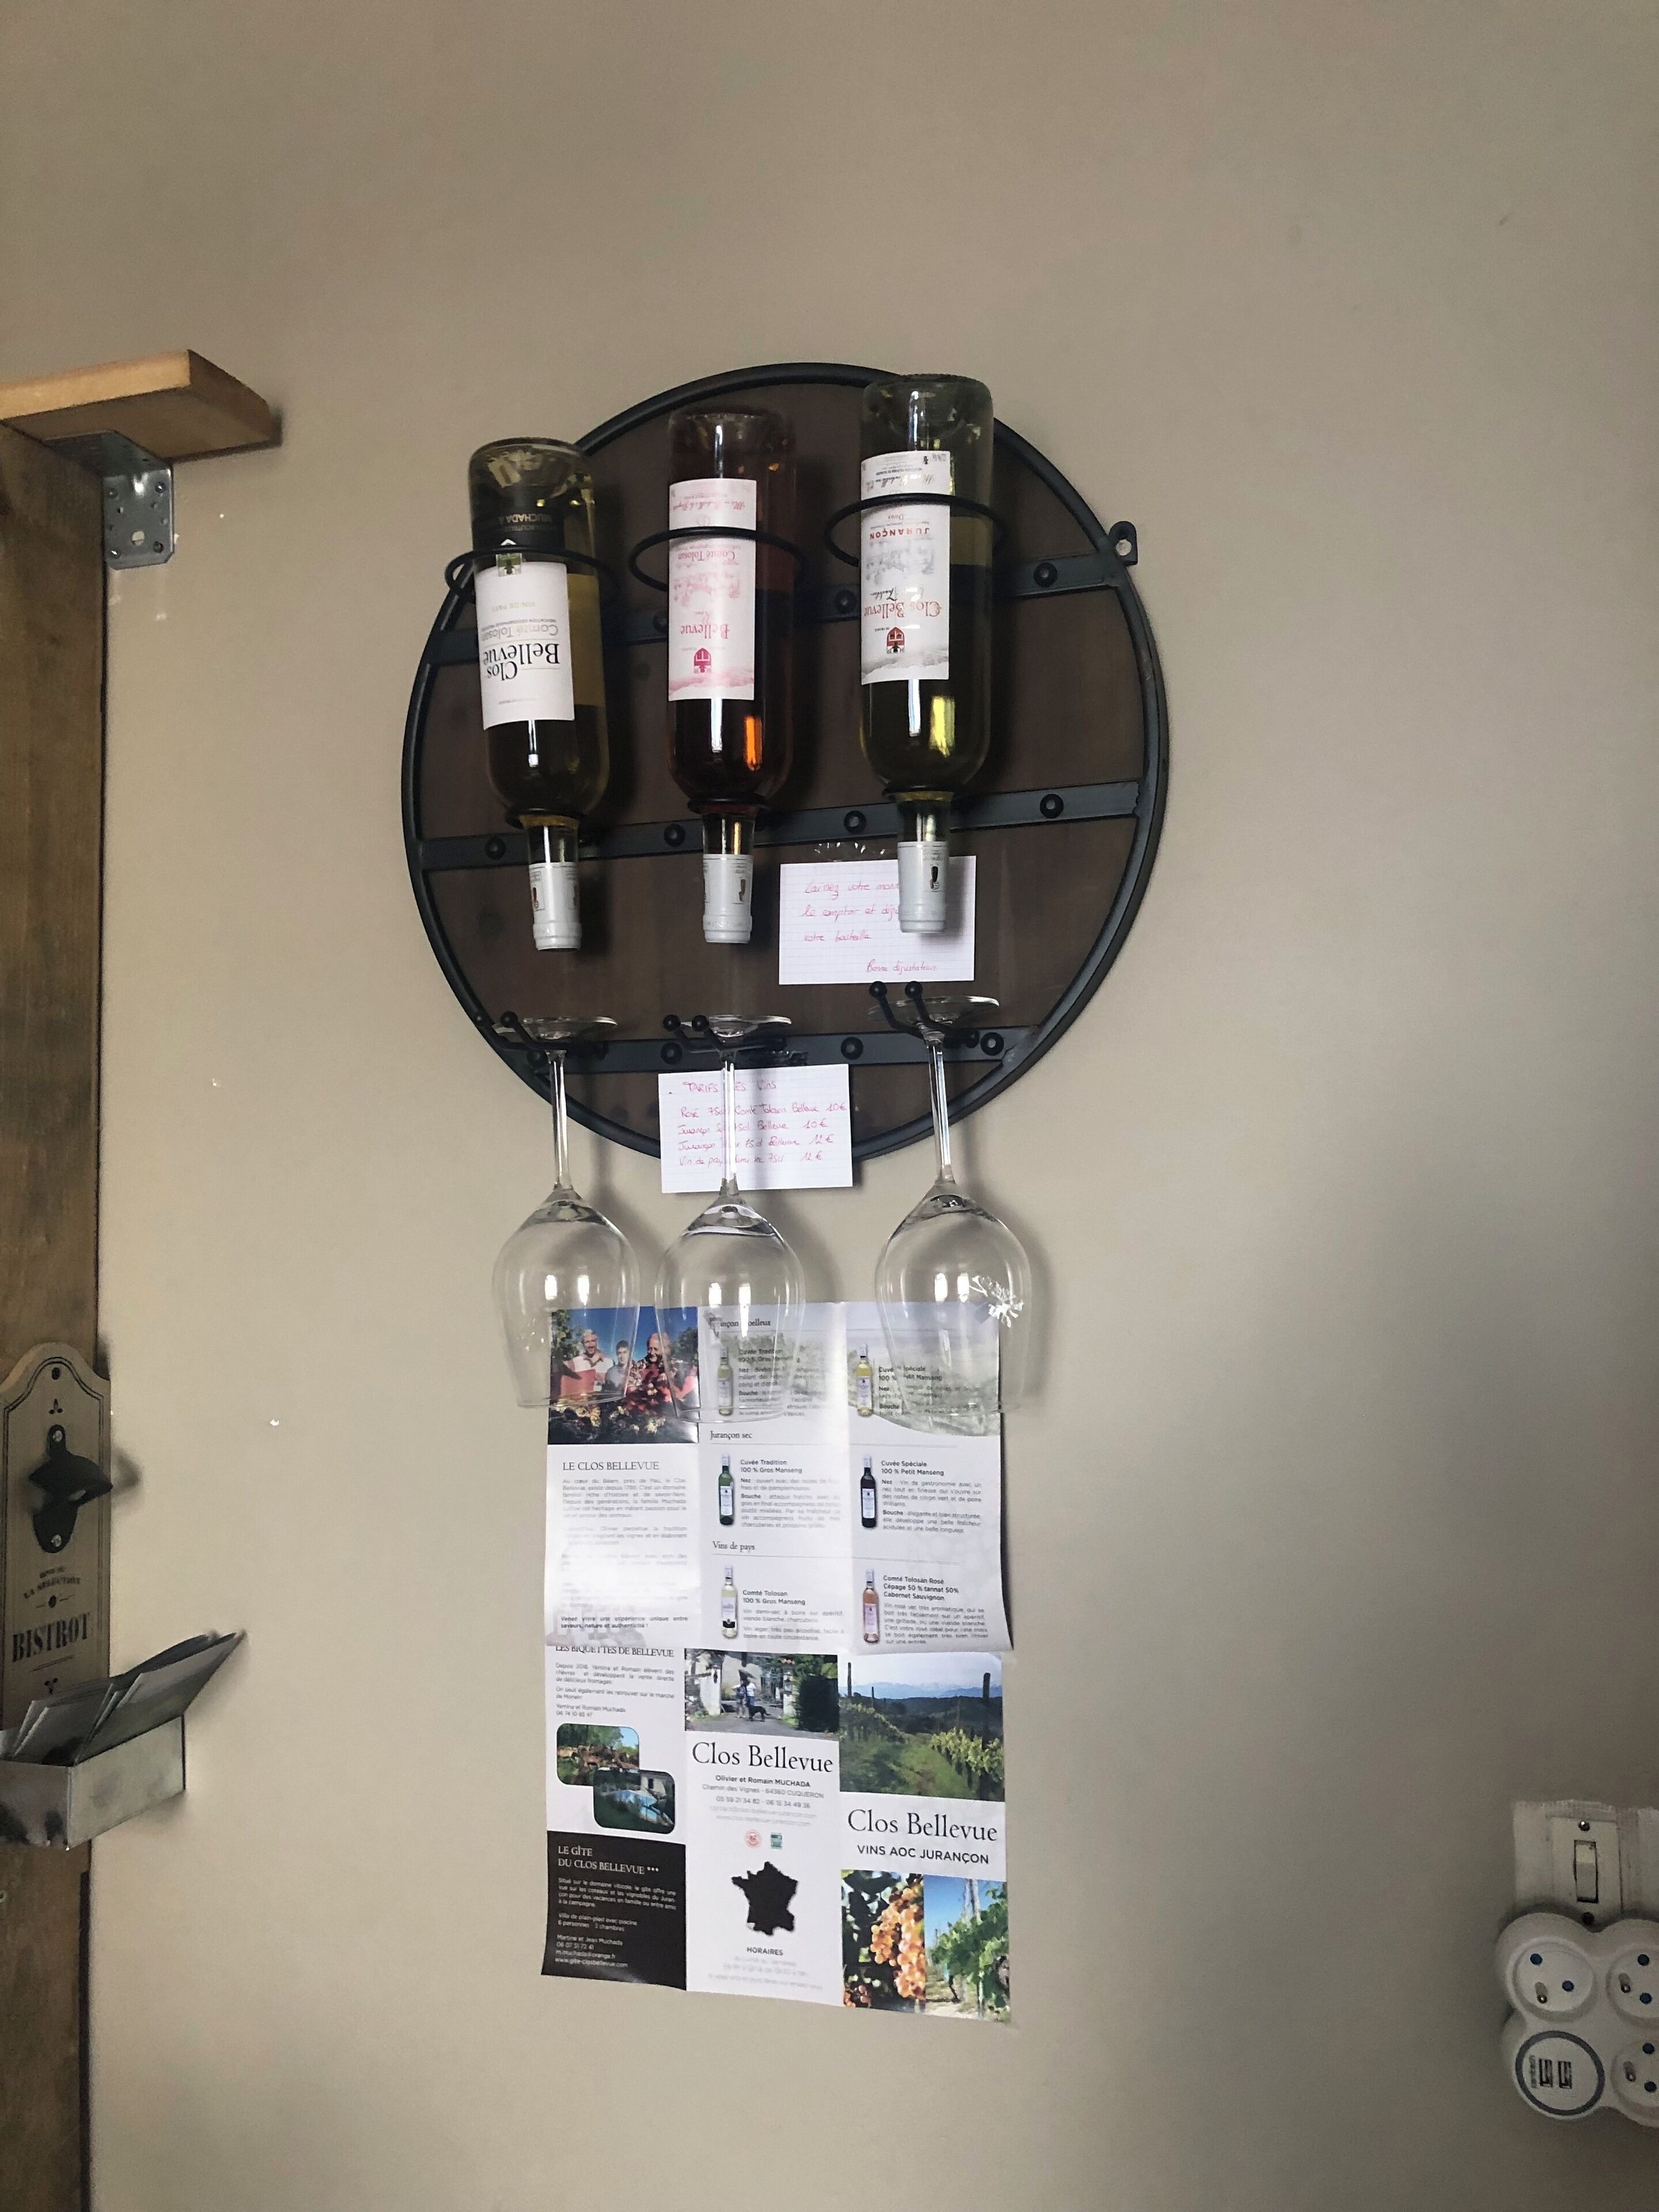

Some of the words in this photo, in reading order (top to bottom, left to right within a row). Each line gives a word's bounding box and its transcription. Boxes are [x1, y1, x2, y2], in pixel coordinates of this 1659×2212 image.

[869, 527, 930, 540] JURANÇON
[706, 550, 736, 562] Comté
[862, 602, 904, 620] Bellevue
[910, 601, 942, 618] Clos
[516, 624, 559, 638] Comté
[680, 624, 729, 639] Bellevue
[482, 642, 560, 668] Bellevue
[486, 660, 518, 681] Clos
[848, 880, 870, 892] votre
[865, 903, 876, 915] et
[835, 930, 872, 942] bouteille
[683, 1081, 718, 1093] TARIFS
[748, 1318, 771, 1327] oelleux
[710, 1430, 741, 1441] Jurançon
[562, 1461, 575, 1471] LE
[577, 1461, 604, 1471] CLOS
[606, 1461, 659, 1471] BELLEVUE
[711, 1540, 728, 1550] Vins
[729, 1541, 738, 1550] de
[740, 1544, 755, 1553] pays
[912, 1593, 945, 1601] Sauvignon
[13, 1612, 90, 1662] BISTROT
[619, 1647, 630, 1655] DE
[631, 1647, 674, 1657] BELLEVUE
[692, 1741, 740, 1766] Clos
[748, 1744, 834, 1772] Bellevue
[702, 1783, 725, 1791] Chemin
[715, 1774, 737, 1782] Olivier
[748, 1777, 773, 1785] Romain
[775, 1779, 810, 1788] MUCHADA
[848, 1809, 899, 1834] Clos
[907, 1811, 998, 1842] Bellevue
[558, 1846, 570, 1854] LE
[571, 1844, 594, 1857] GÎTE
[857, 1844, 886, 1855] VINS
[889, 1846, 916, 1858] AOC
[920, 1849, 990, 1865] JURANÇON
[558, 1858, 572, 1868] DU
[574, 1859, 598, 1870] CLOS
[599, 1862, 645, 1875] BELLEVUE
[746, 1946, 783, 1956] HORAIRES
